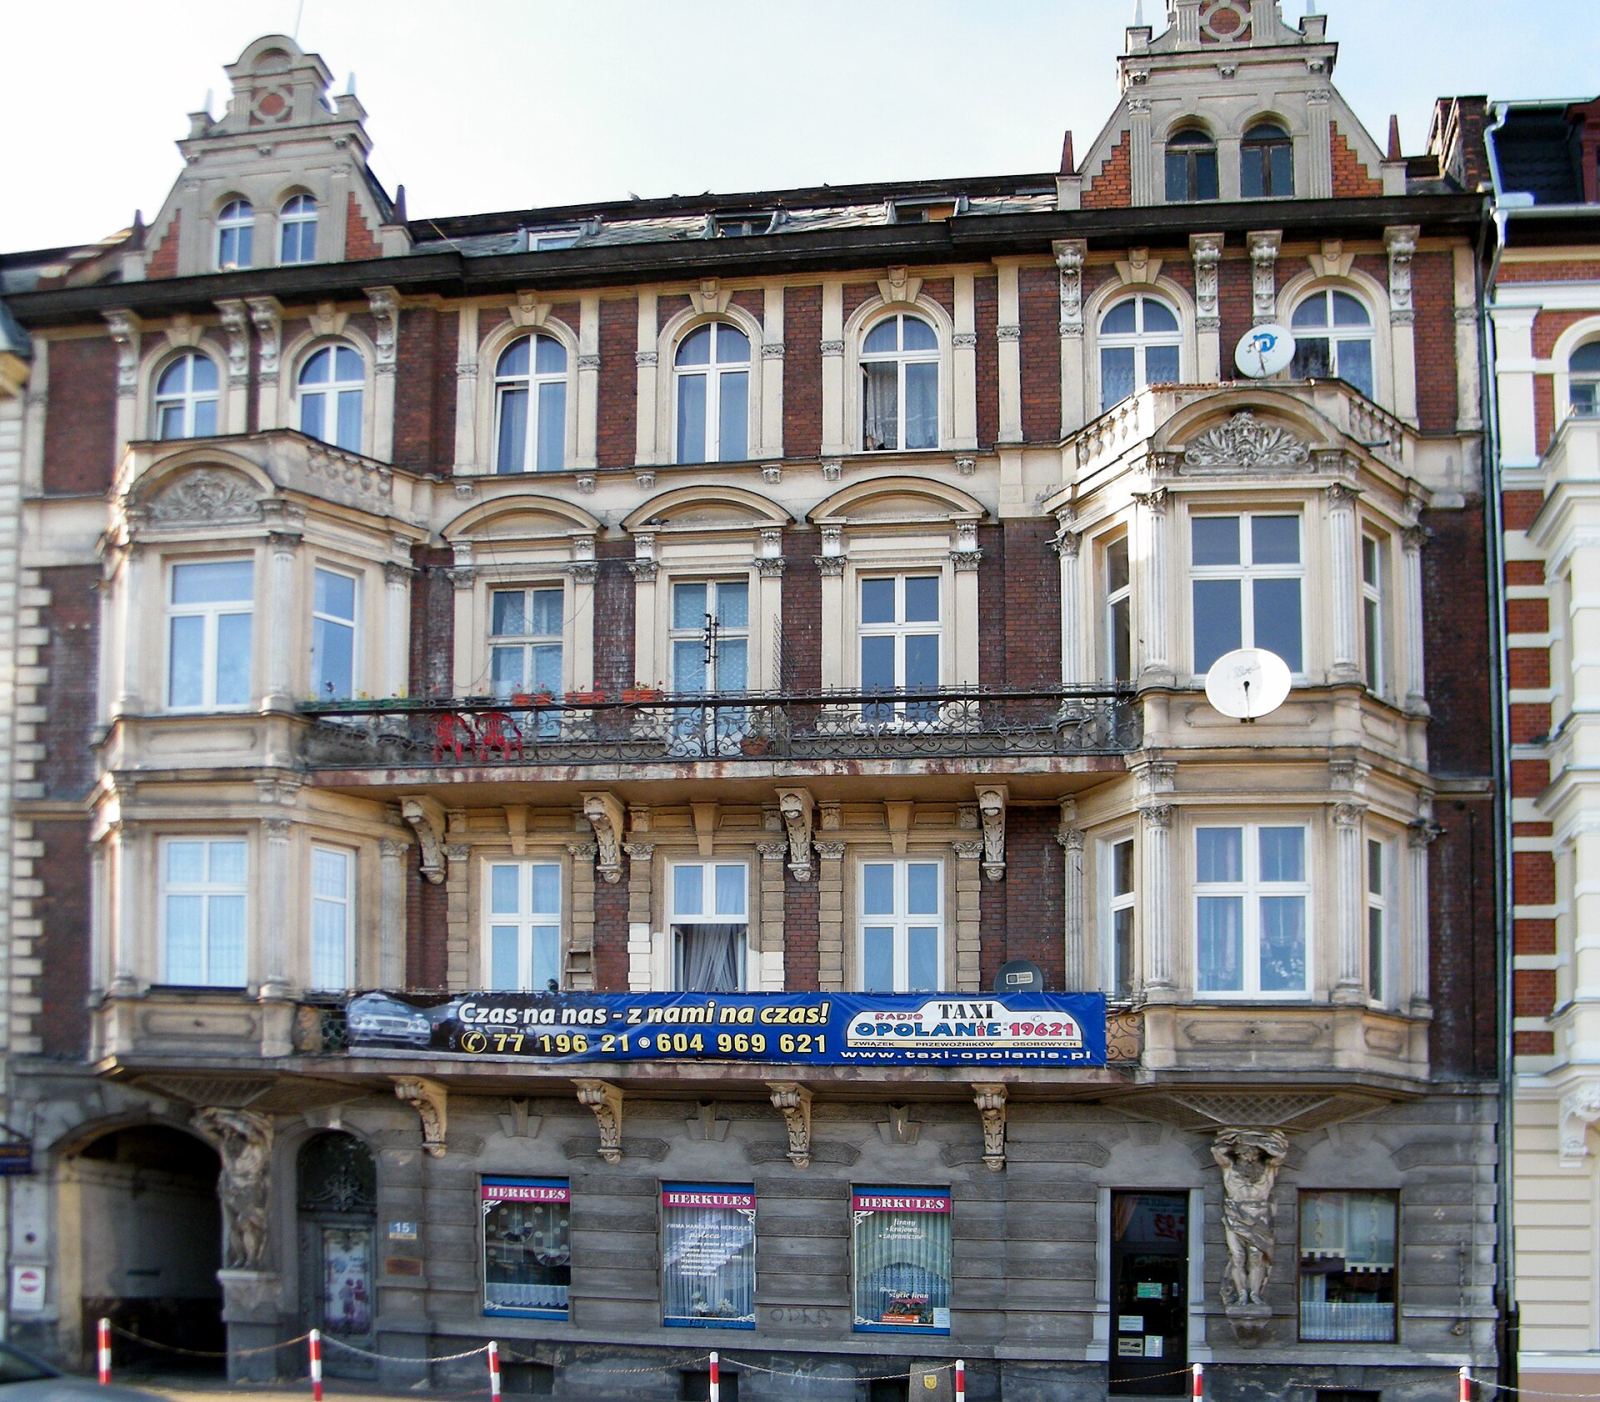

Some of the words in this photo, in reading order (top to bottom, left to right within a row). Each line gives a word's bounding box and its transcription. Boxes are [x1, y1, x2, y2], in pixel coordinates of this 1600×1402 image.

[458, 1002, 517, 1024] Czas
[523, 1008, 555, 1024] na
[561, 1008, 607, 1025] nas
[627, 1008, 642, 1024] z
[647, 1001, 715, 1023] nami
[719, 1007, 755, 1024] na
[760, 1002, 829, 1024] czas!
[938, 1003, 993, 1019] TAXI
[493, 1033, 525, 1052] 77
[540, 1034, 588, 1053] 196
[601, 1034, 629, 1052] 21
[656, 1033, 704, 1052] 604
[717, 1033, 766, 1053] 969
[779, 1034, 825, 1053] 621
[840, 1050, 1091, 1060] www.taxi-opolanie.pl
[487, 1187, 566, 1199] HERKULES
[669, 1194, 751, 1206] HERKULES
[859, 1198, 945, 1209] HERKULES
